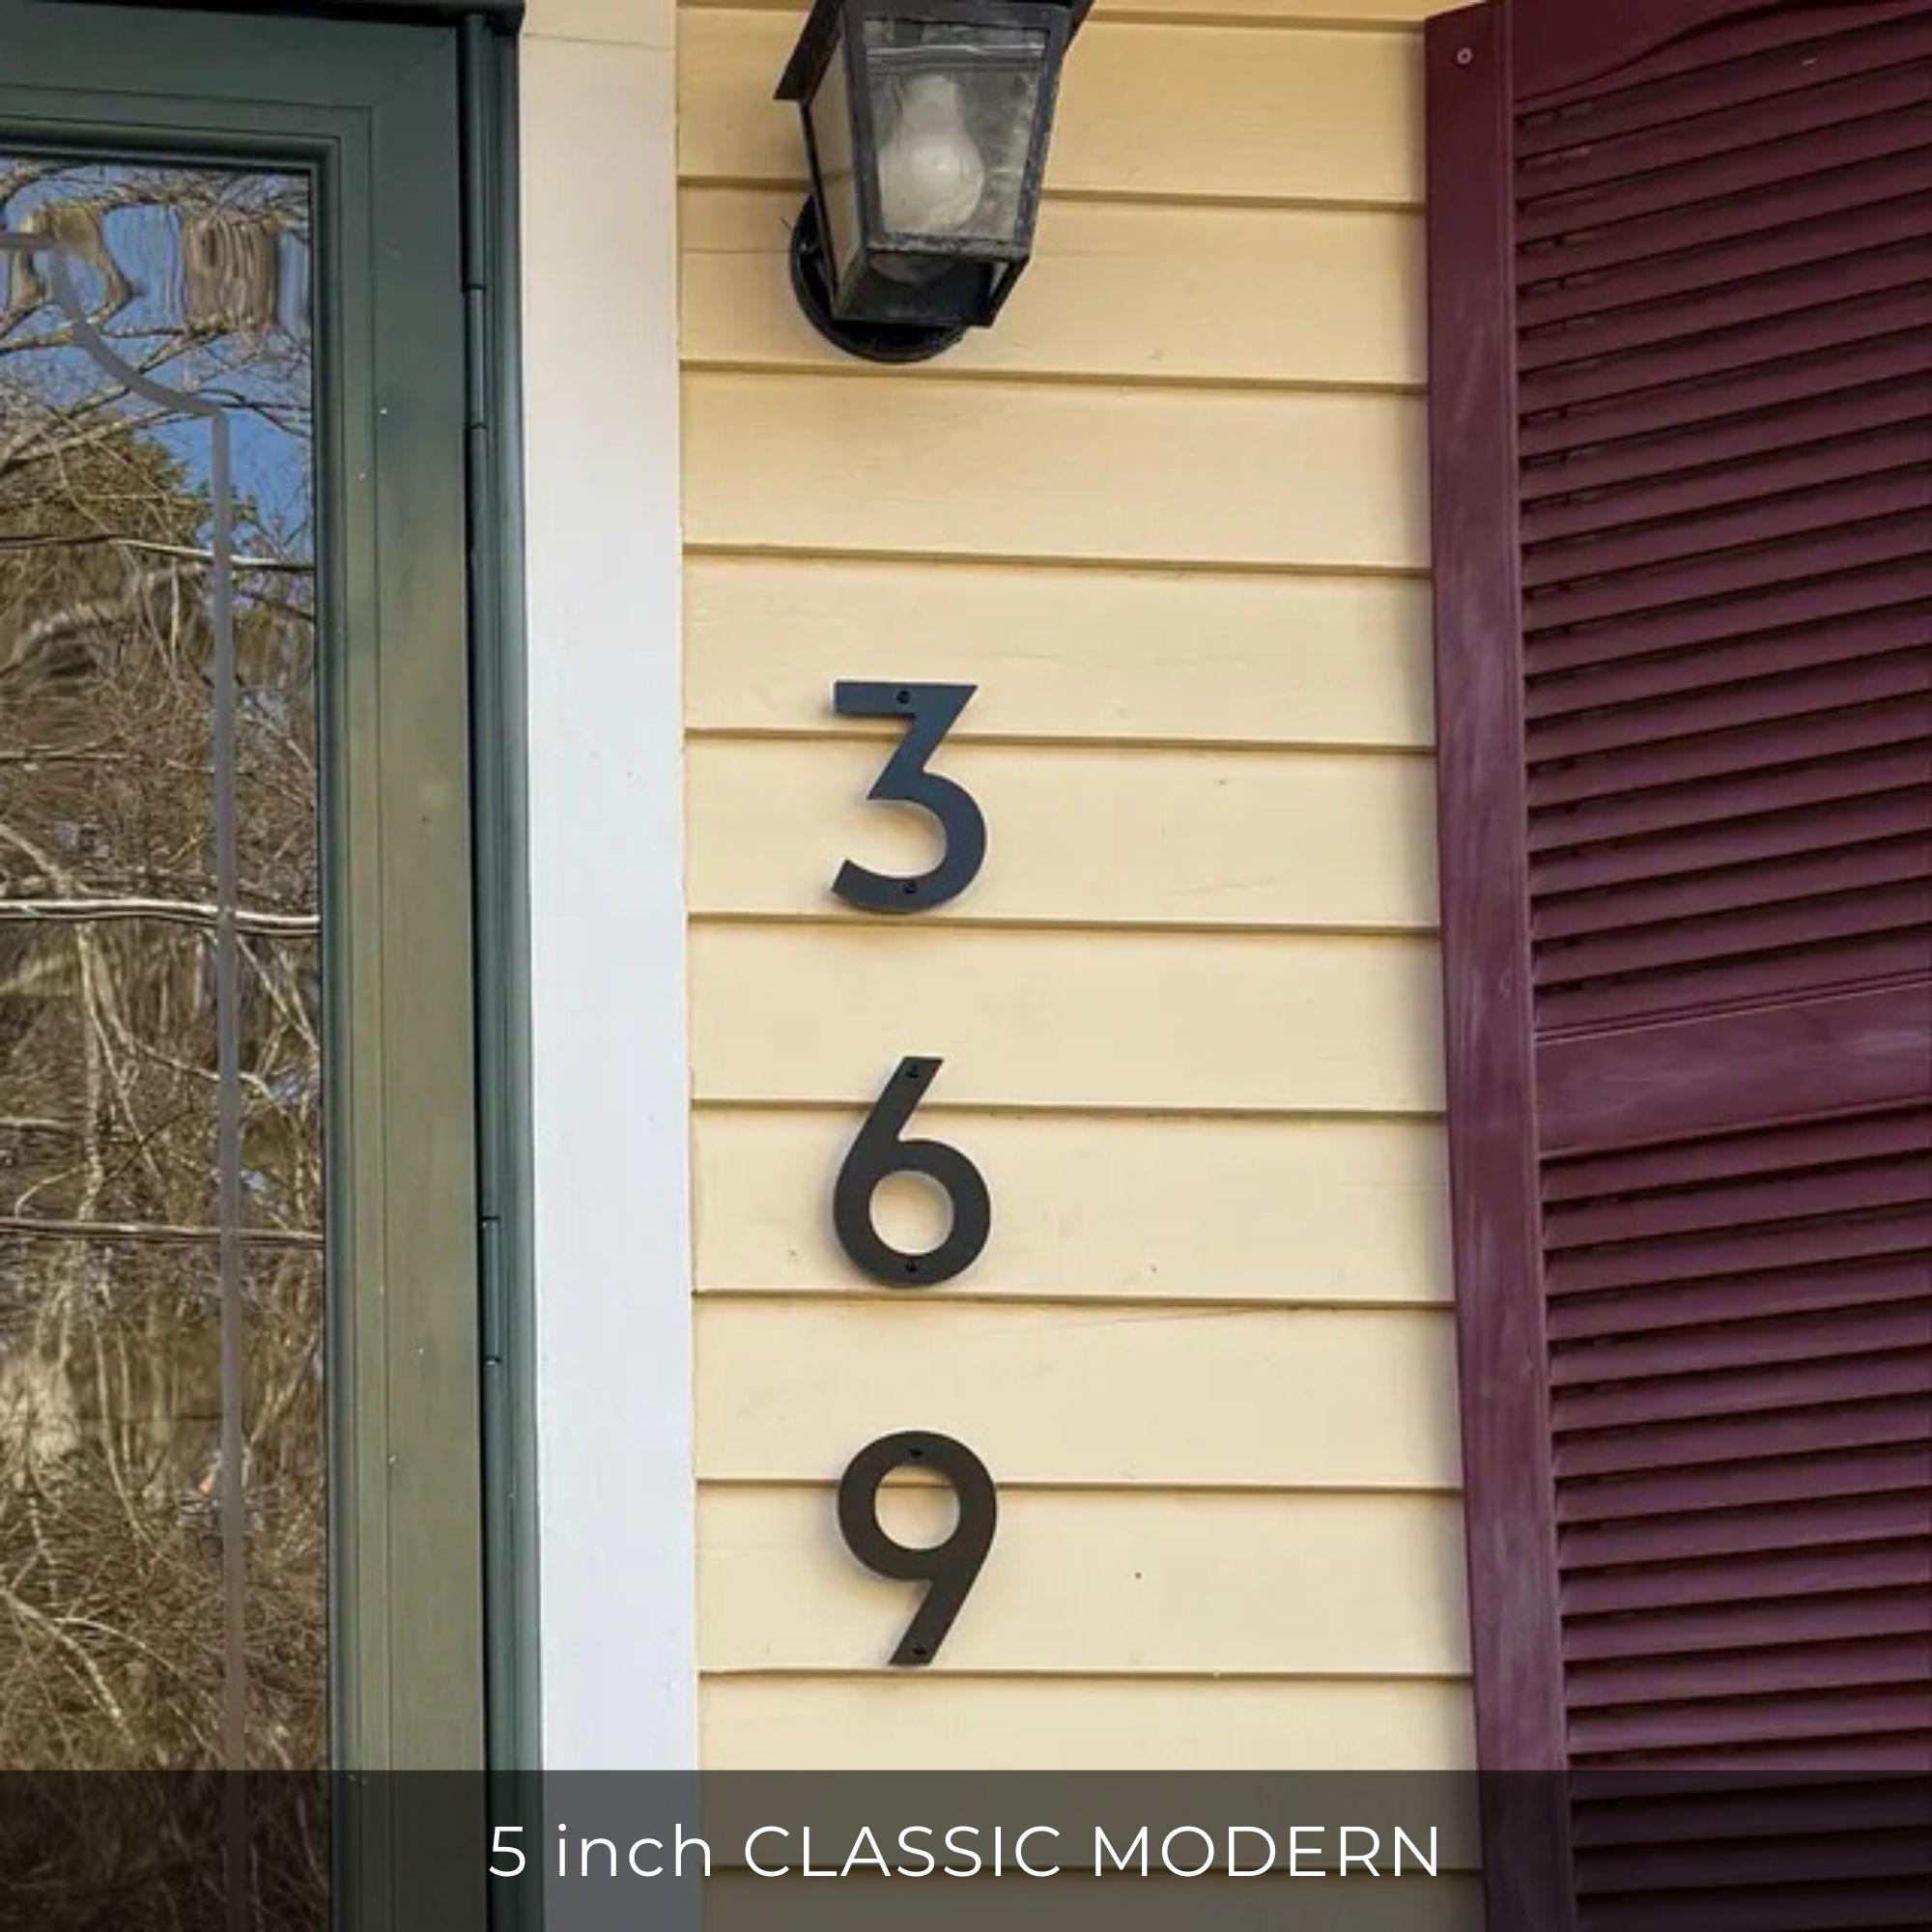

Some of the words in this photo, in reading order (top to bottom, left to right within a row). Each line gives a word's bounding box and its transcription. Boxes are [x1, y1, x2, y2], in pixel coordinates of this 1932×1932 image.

[832, 680, 987, 912] 3
[833, 1056, 991, 1287] 6
[837, 1431, 997, 1666] 9
